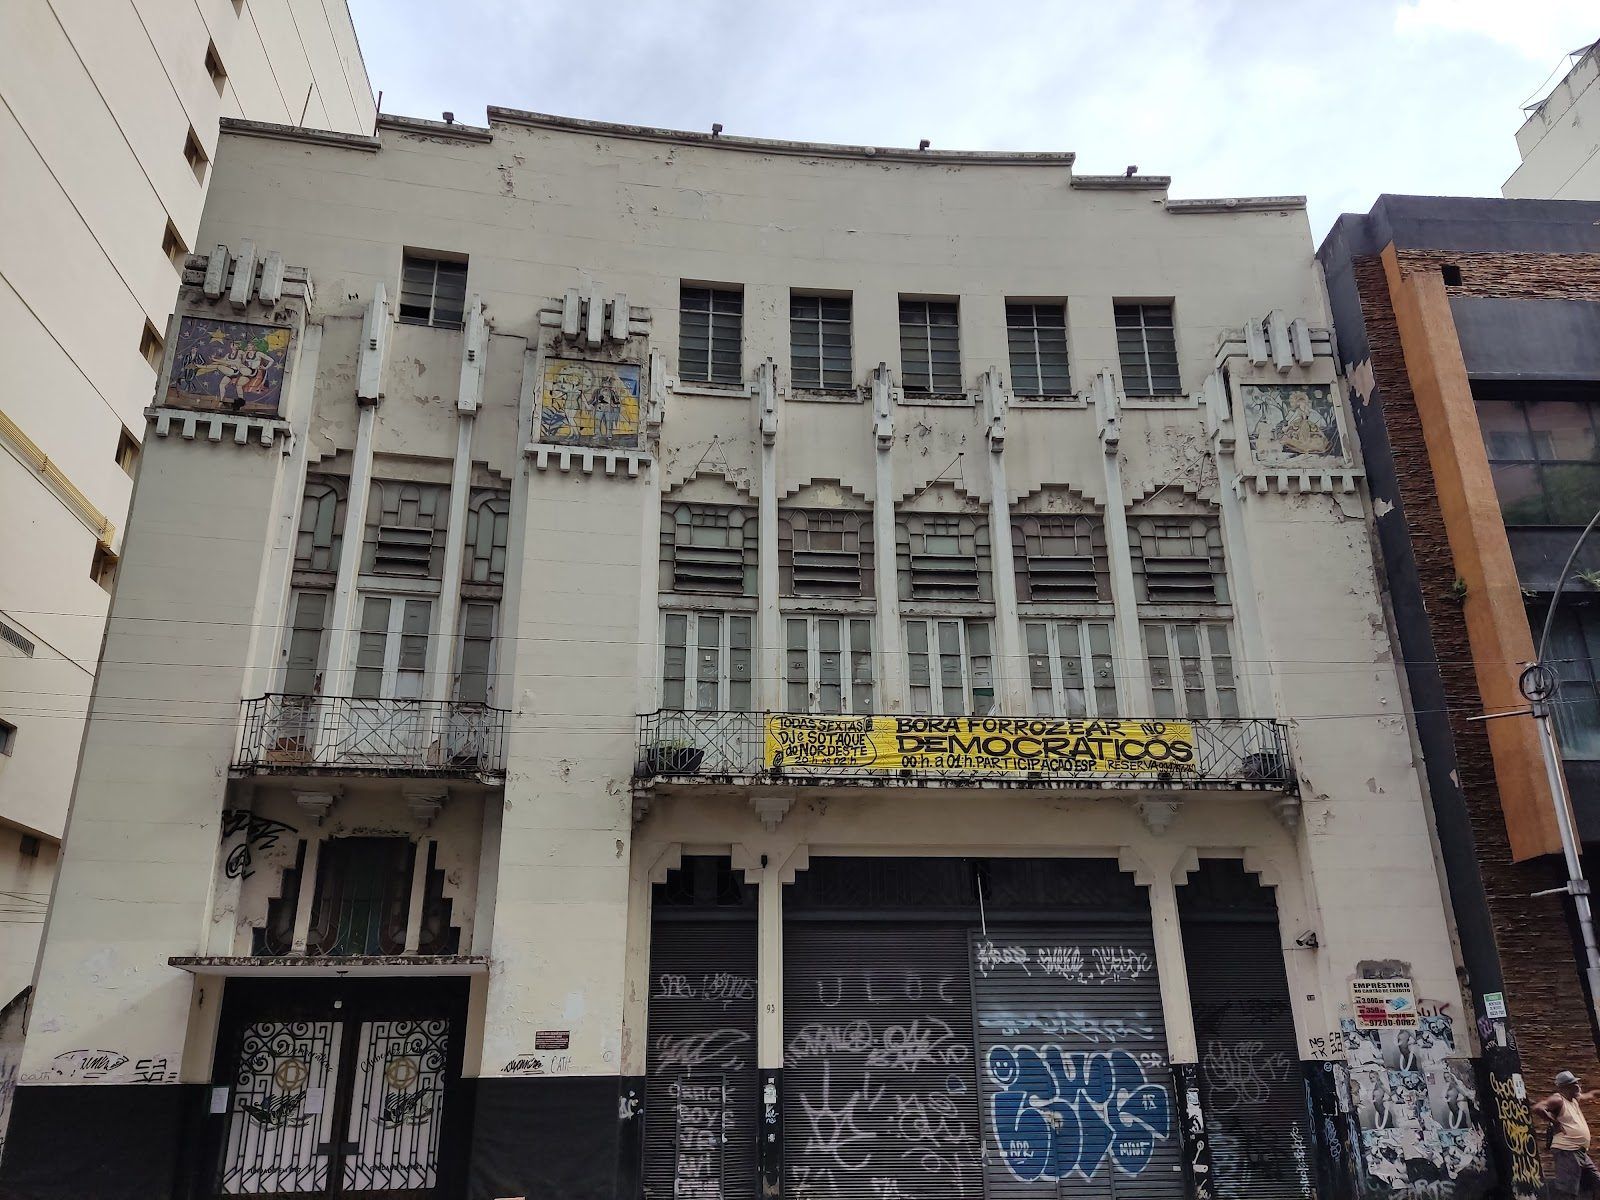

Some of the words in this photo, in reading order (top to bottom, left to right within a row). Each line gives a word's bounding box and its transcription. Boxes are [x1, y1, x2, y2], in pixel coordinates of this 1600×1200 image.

[776, 717, 816, 730] TODAS
[817, 719, 863, 732] SEXTAS
[895, 717, 961, 733] BORA
[967, 717, 1126, 737] FORROZEAR
[1140, 722, 1166, 735] NO
[778, 730, 796, 744] DJ
[808, 731, 866, 746] SOTAQUE
[800, 742, 868, 757] NORDESTE
[1107, 760, 1158, 771] RESERVA
